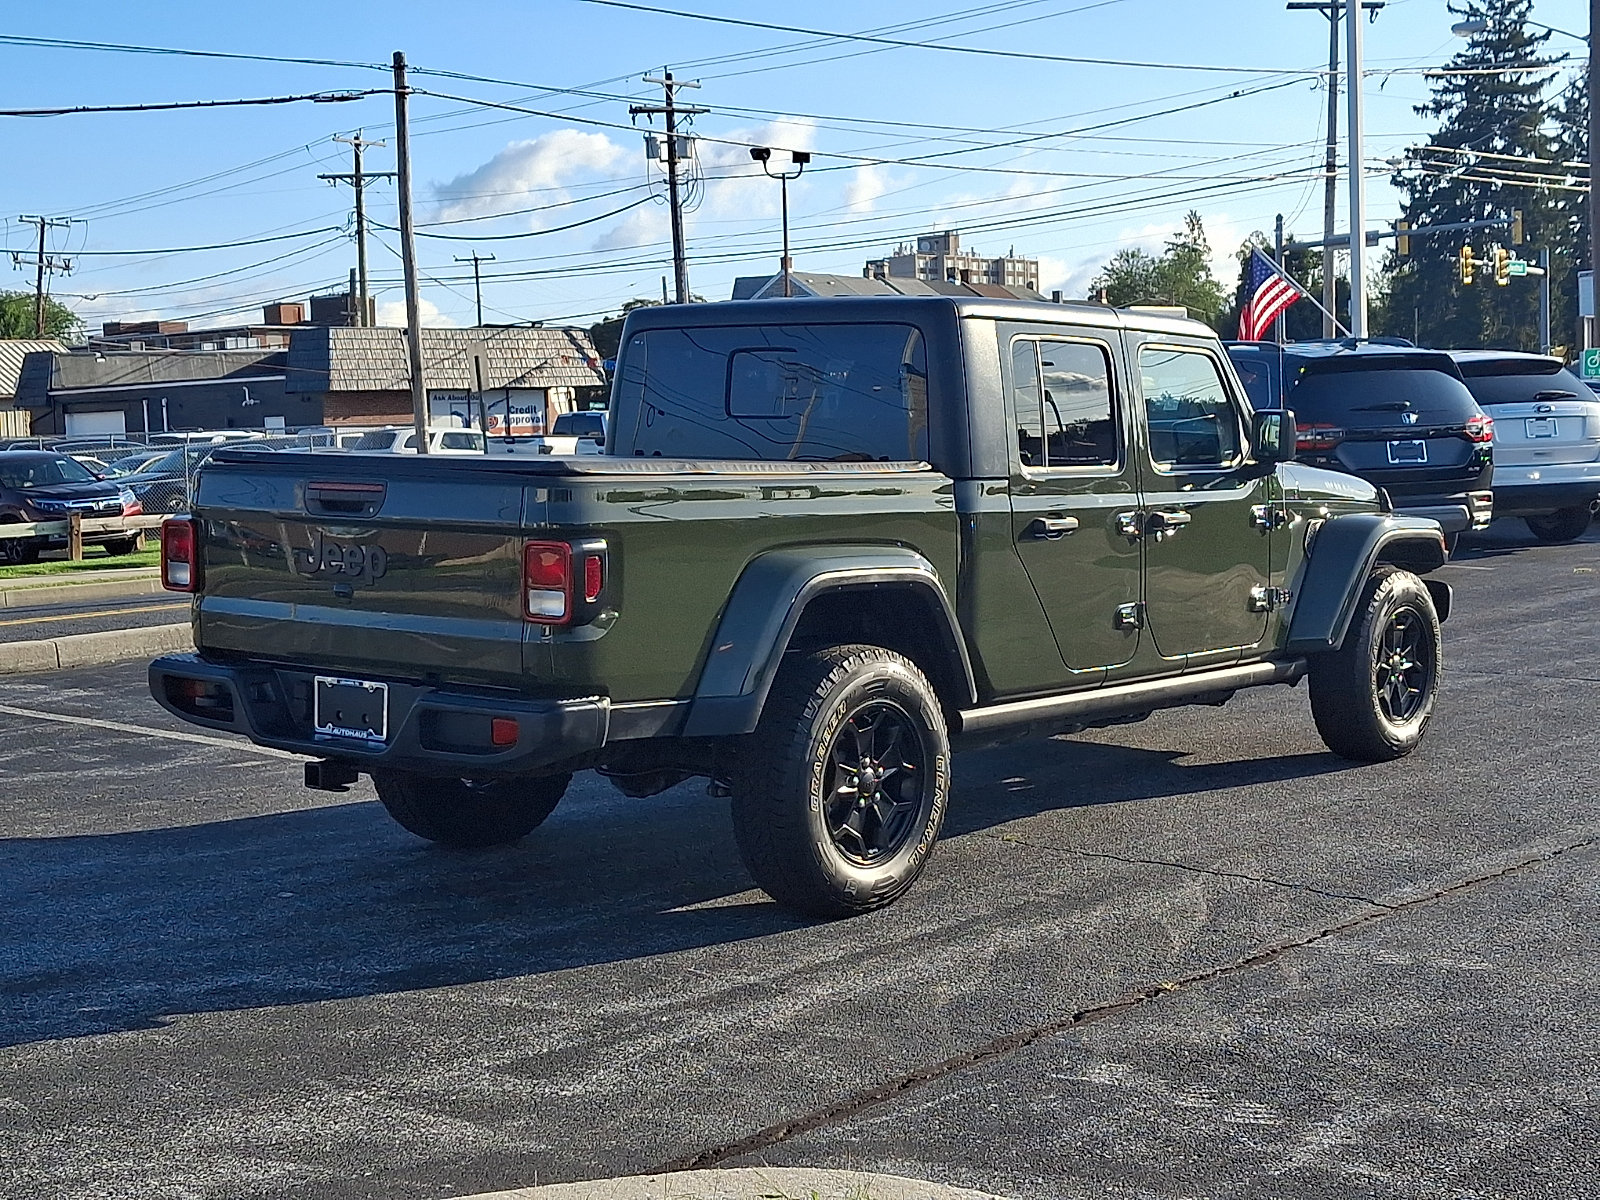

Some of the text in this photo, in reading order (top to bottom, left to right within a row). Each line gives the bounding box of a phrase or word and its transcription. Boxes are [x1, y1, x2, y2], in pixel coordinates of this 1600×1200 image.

[501, 414, 544, 426] Approval
[509, 405, 537, 415] Credit
[294, 529, 387, 586] Jeep
[332, 727, 368, 739] AUTOHAUS
[810, 699, 848, 812] GRABBER
[908, 754, 945, 866] GENERAL
